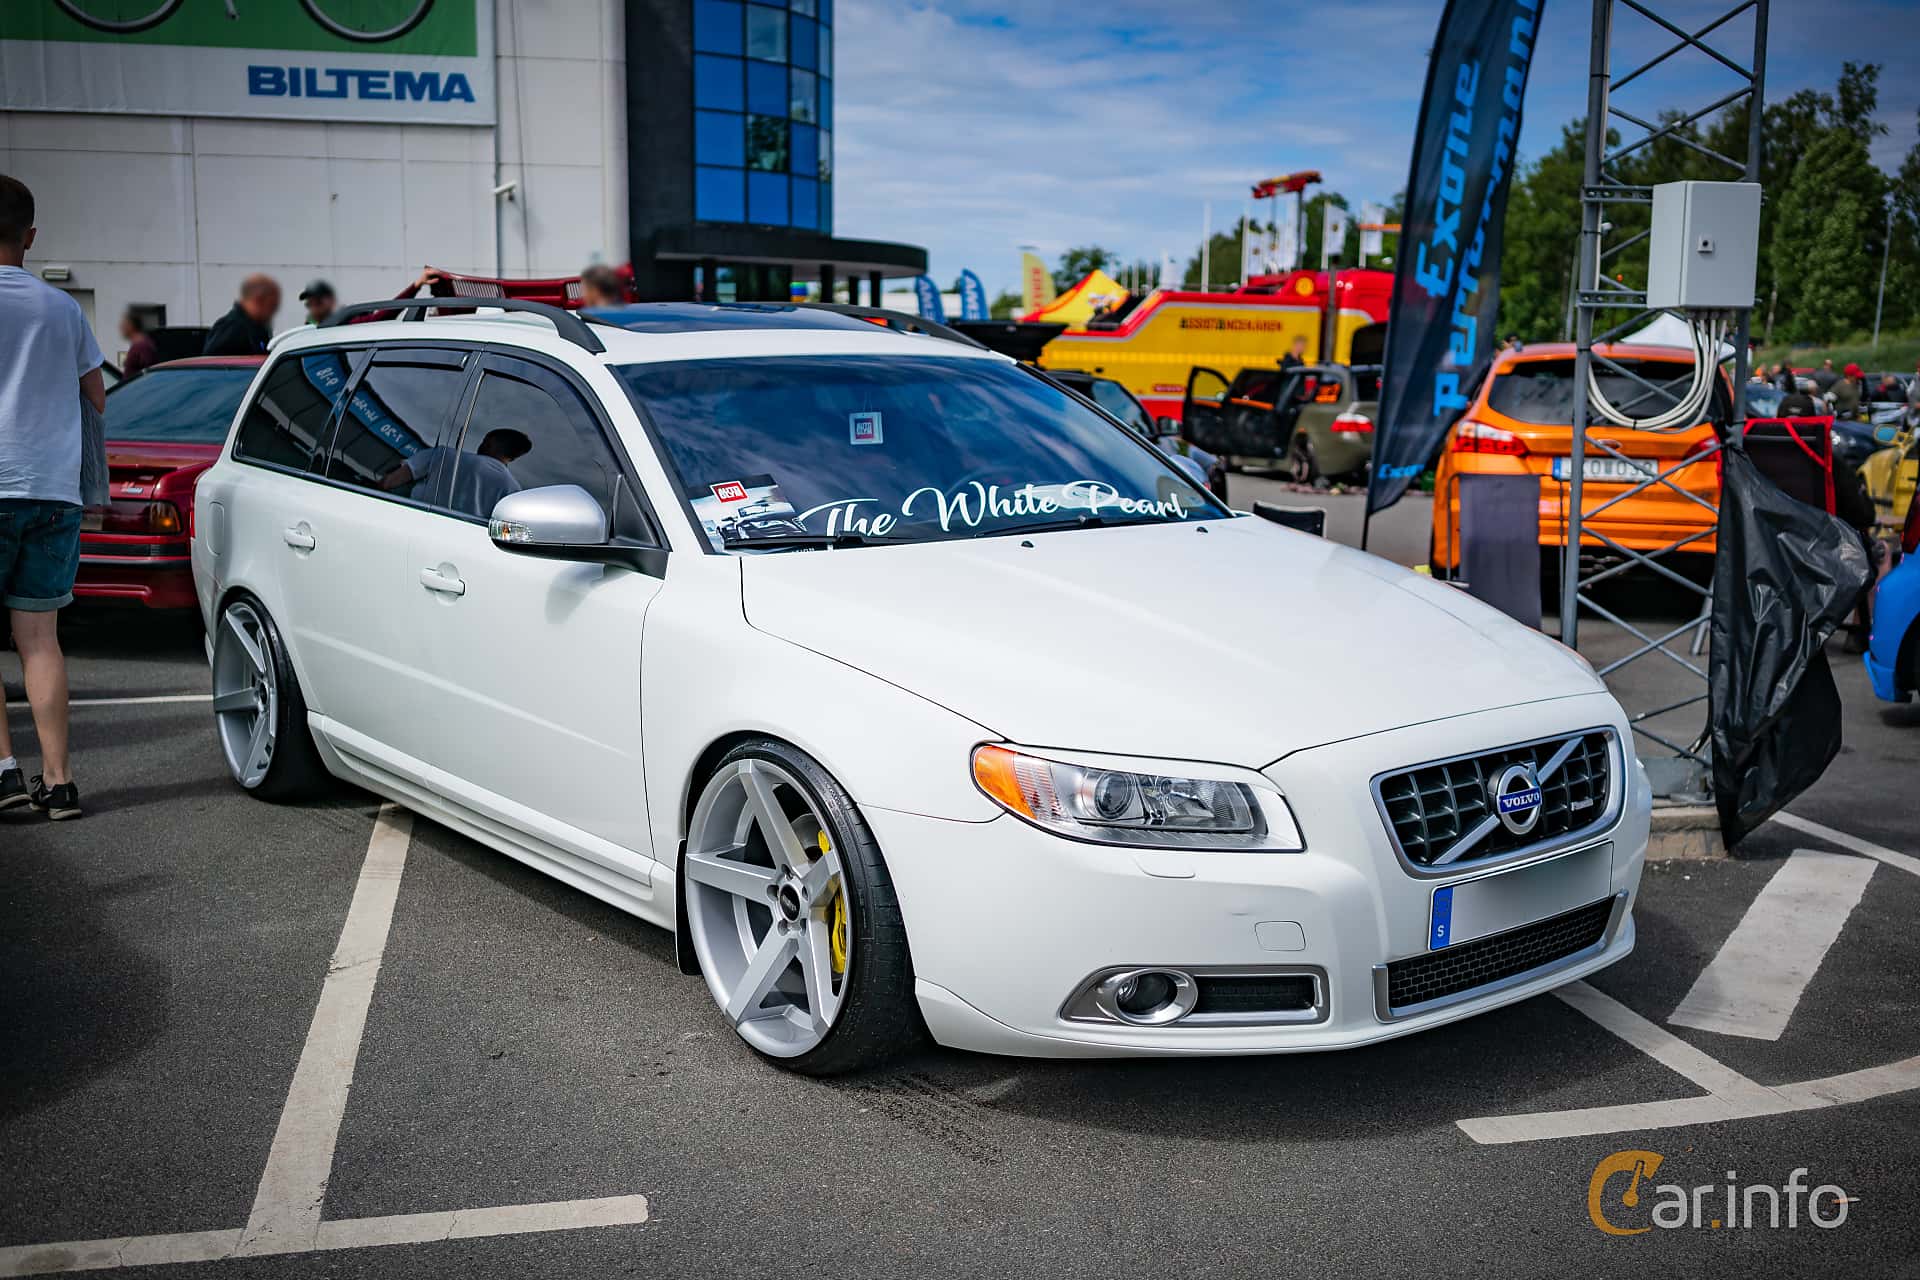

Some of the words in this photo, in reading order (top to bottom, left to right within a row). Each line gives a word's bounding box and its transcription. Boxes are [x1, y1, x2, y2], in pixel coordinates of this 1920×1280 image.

[248, 65, 476, 103] BILTEMA
[1415, 59, 1480, 299] Exone
[793, 498, 897, 537] The
[902, 480, 1060, 532] White
[1062, 480, 1188, 519] Pearl
[1502, 792, 1540, 808] VOLVO
[1437, 924, 1445, 937] S
